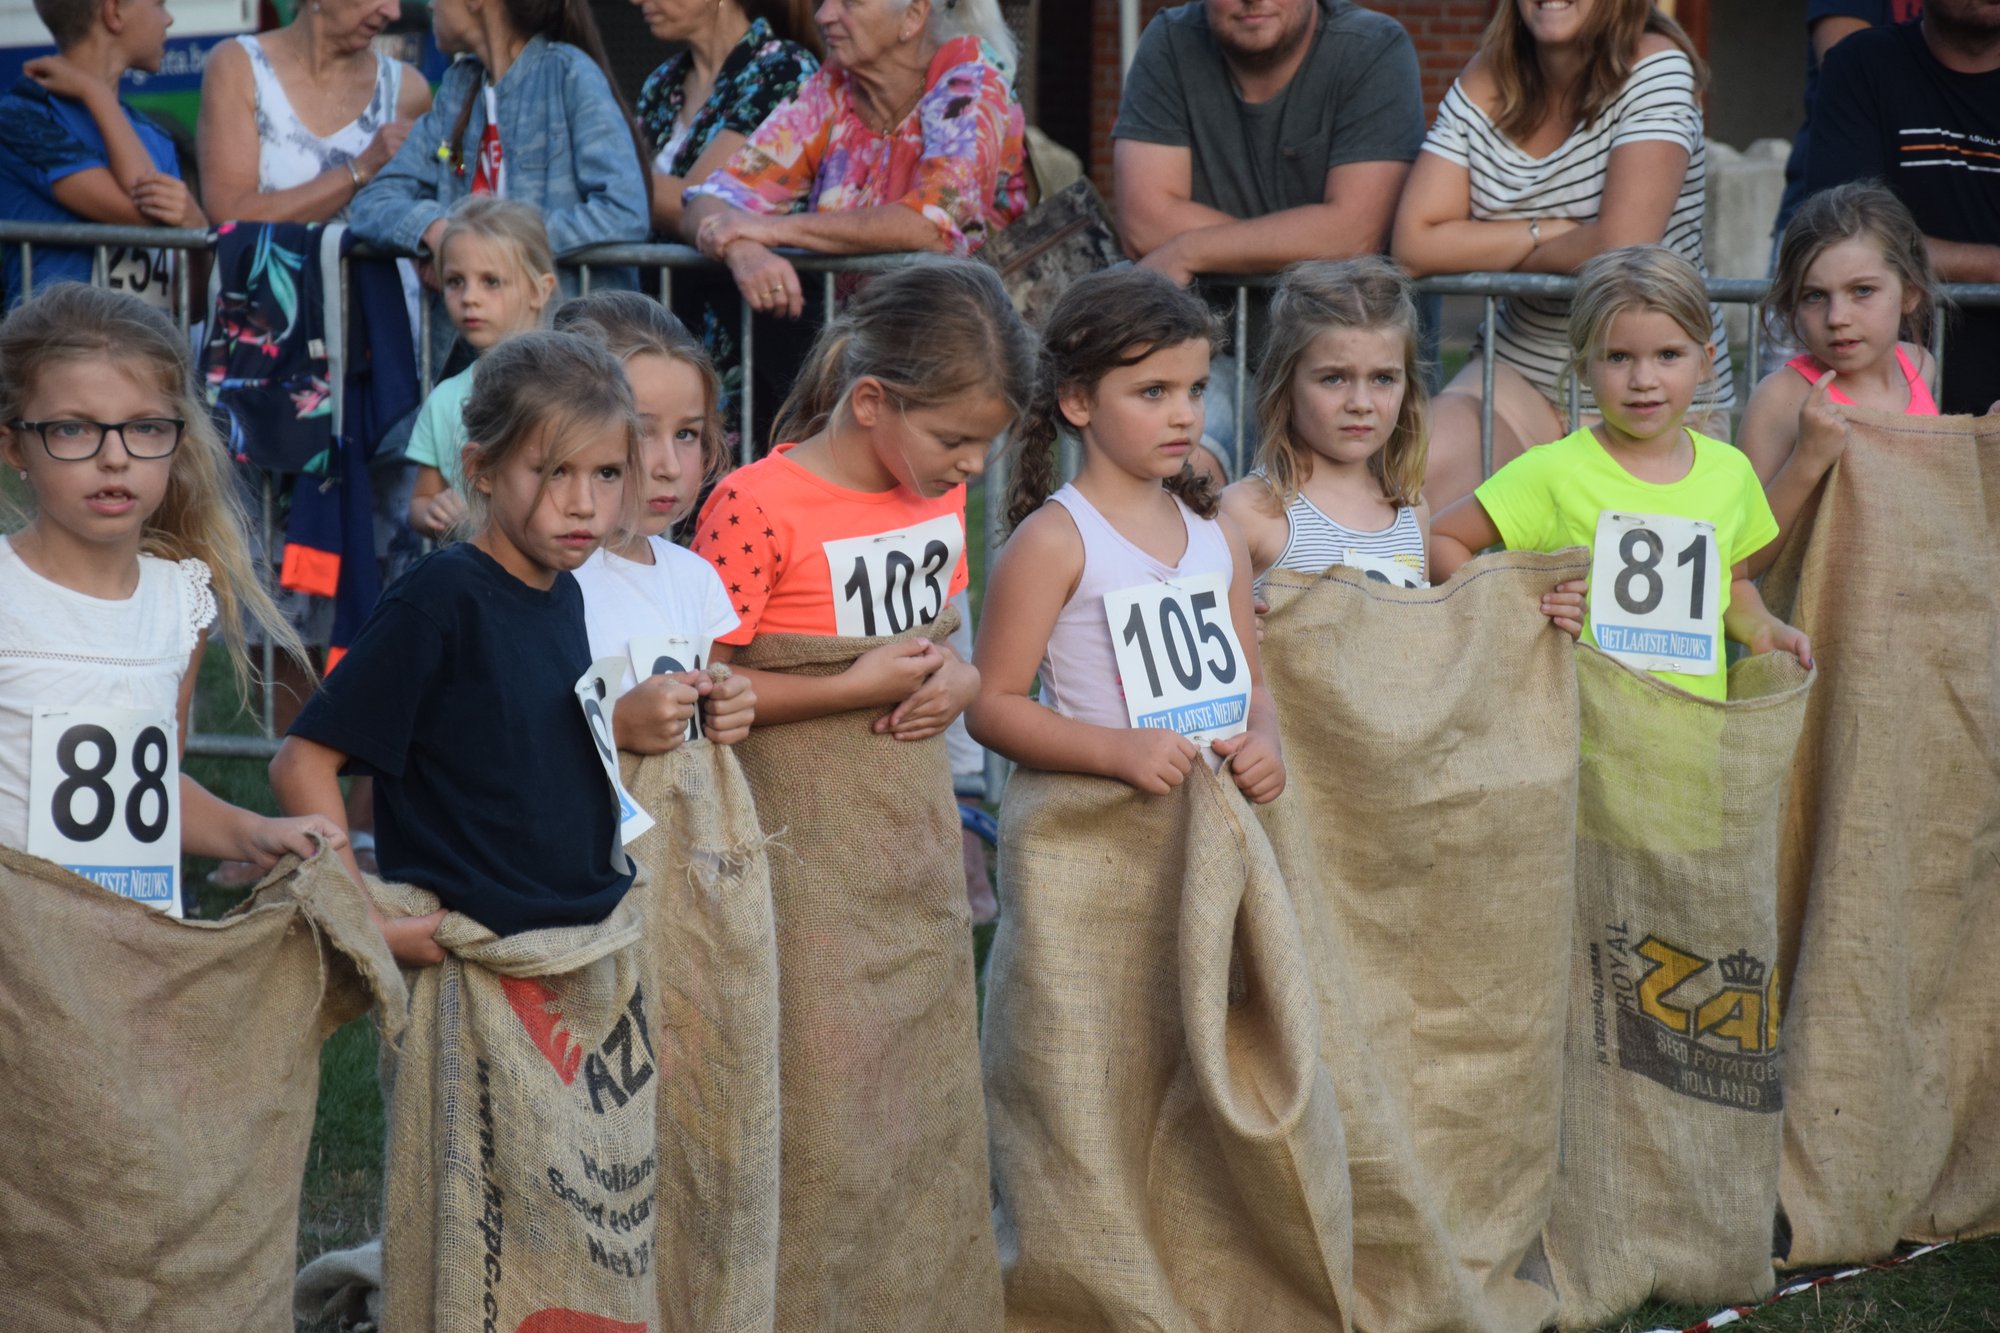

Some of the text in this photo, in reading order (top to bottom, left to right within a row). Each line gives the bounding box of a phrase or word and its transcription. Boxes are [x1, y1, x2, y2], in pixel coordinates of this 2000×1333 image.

[108, 246, 169, 297] 254
[844, 539, 949, 637] 103
[1614, 528, 1707, 620] 81
[1122, 590, 1237, 698] 105
[1601, 626, 1706, 658] HET LAATSTE NIEUWS
[1168, 705, 1215, 735] LAATSTE
[1211, 699, 1244, 727] NIEUWS
[51, 724, 169, 843] 88
[75, 868, 169, 898] ATSTE NIEUWS
[1606, 918, 1640, 1015] ROYAL
[1657, 1031, 1780, 1083] SEED POTATOE
[1681, 1068, 1761, 1107] HOLLAND
[579, 1149, 656, 1193] Hollan
[547, 1166, 656, 1235] Seed pota
[586, 1232, 634, 1278] Net
